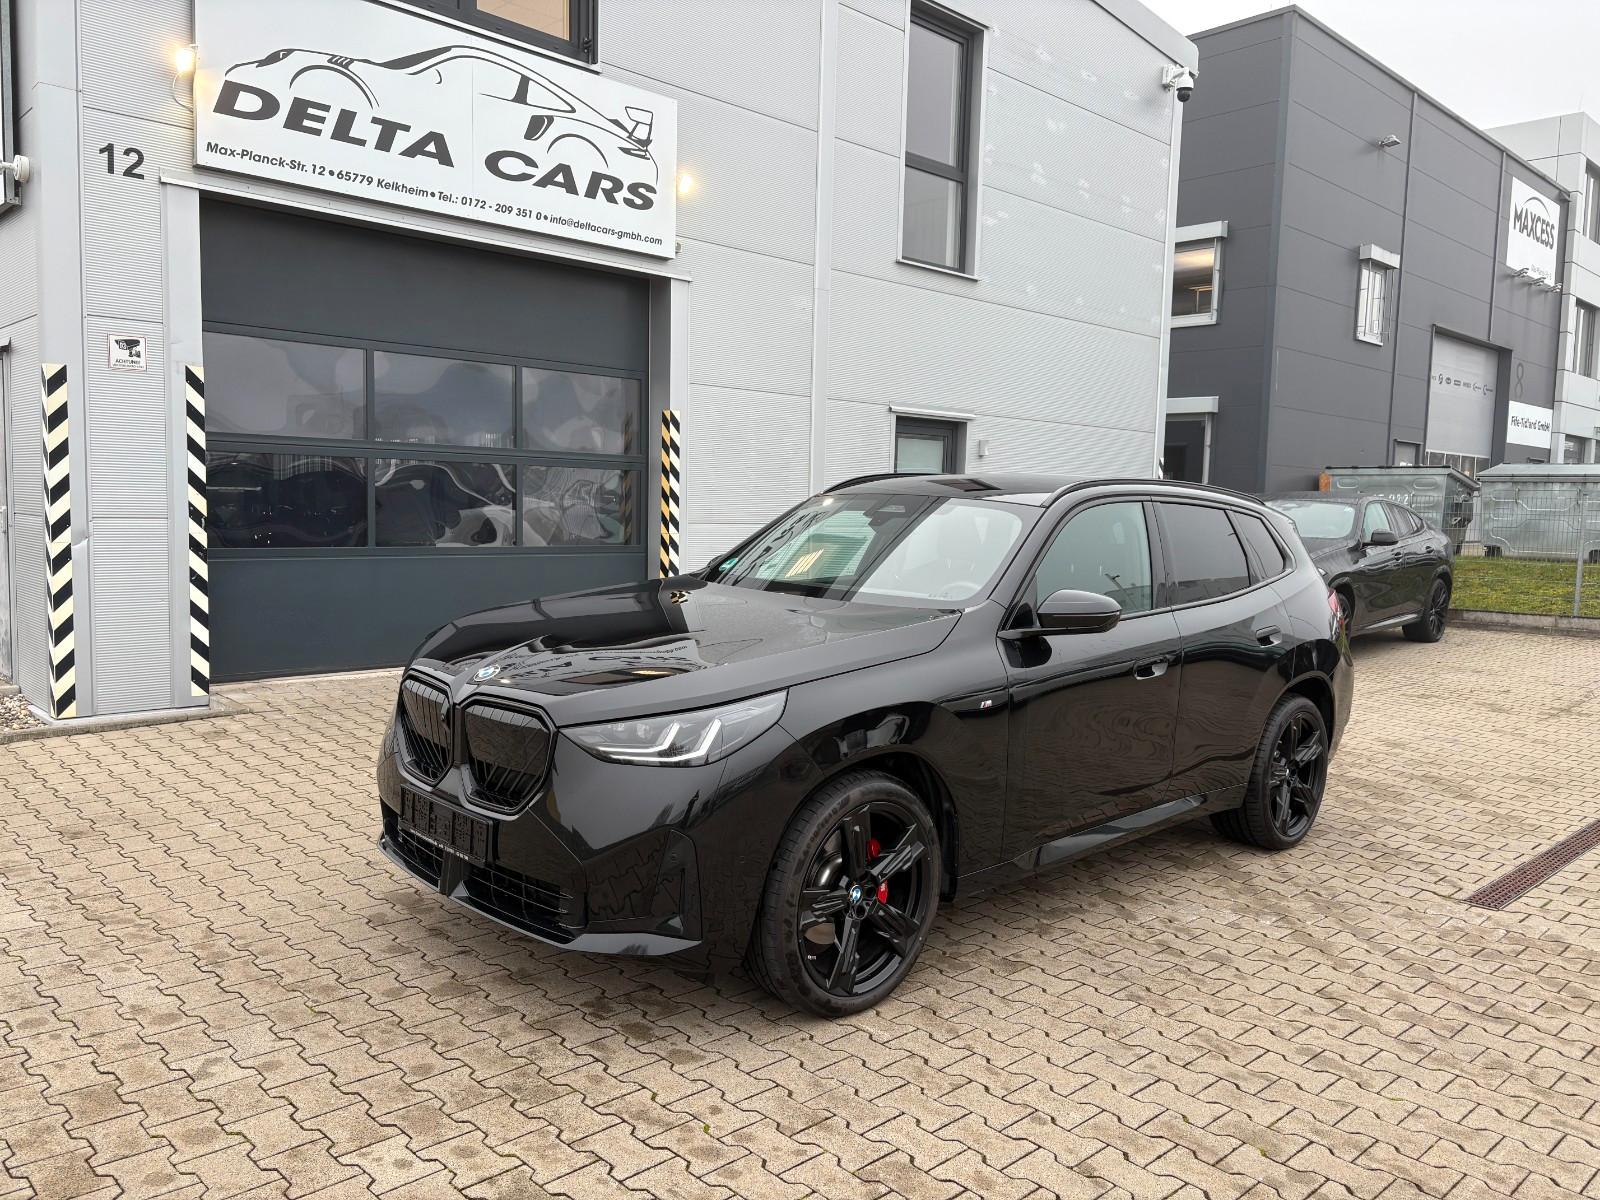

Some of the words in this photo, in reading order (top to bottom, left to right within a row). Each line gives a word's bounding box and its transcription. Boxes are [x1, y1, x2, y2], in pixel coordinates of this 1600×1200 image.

[98, 142, 145, 180] 12
[212, 79, 455, 168] DELTA
[484, 150, 657, 210] CARS
[205, 141, 308, 173] Max-Planck-Str.
[311, 163, 326, 176] 12
[336, 169, 374, 186] 65779
[376, 178, 429, 198] Kelkheim
[437, 191, 459, 204] Tel.:
[461, 196, 487, 210] 0172
[494, 202, 514, 215] 209
[515, 207, 533, 219] 351
[535, 211, 542, 221] 0
[549, 214, 663, 246] info@deltacars-gmbh.com
[1513, 202, 1555, 250] MAXCESS
